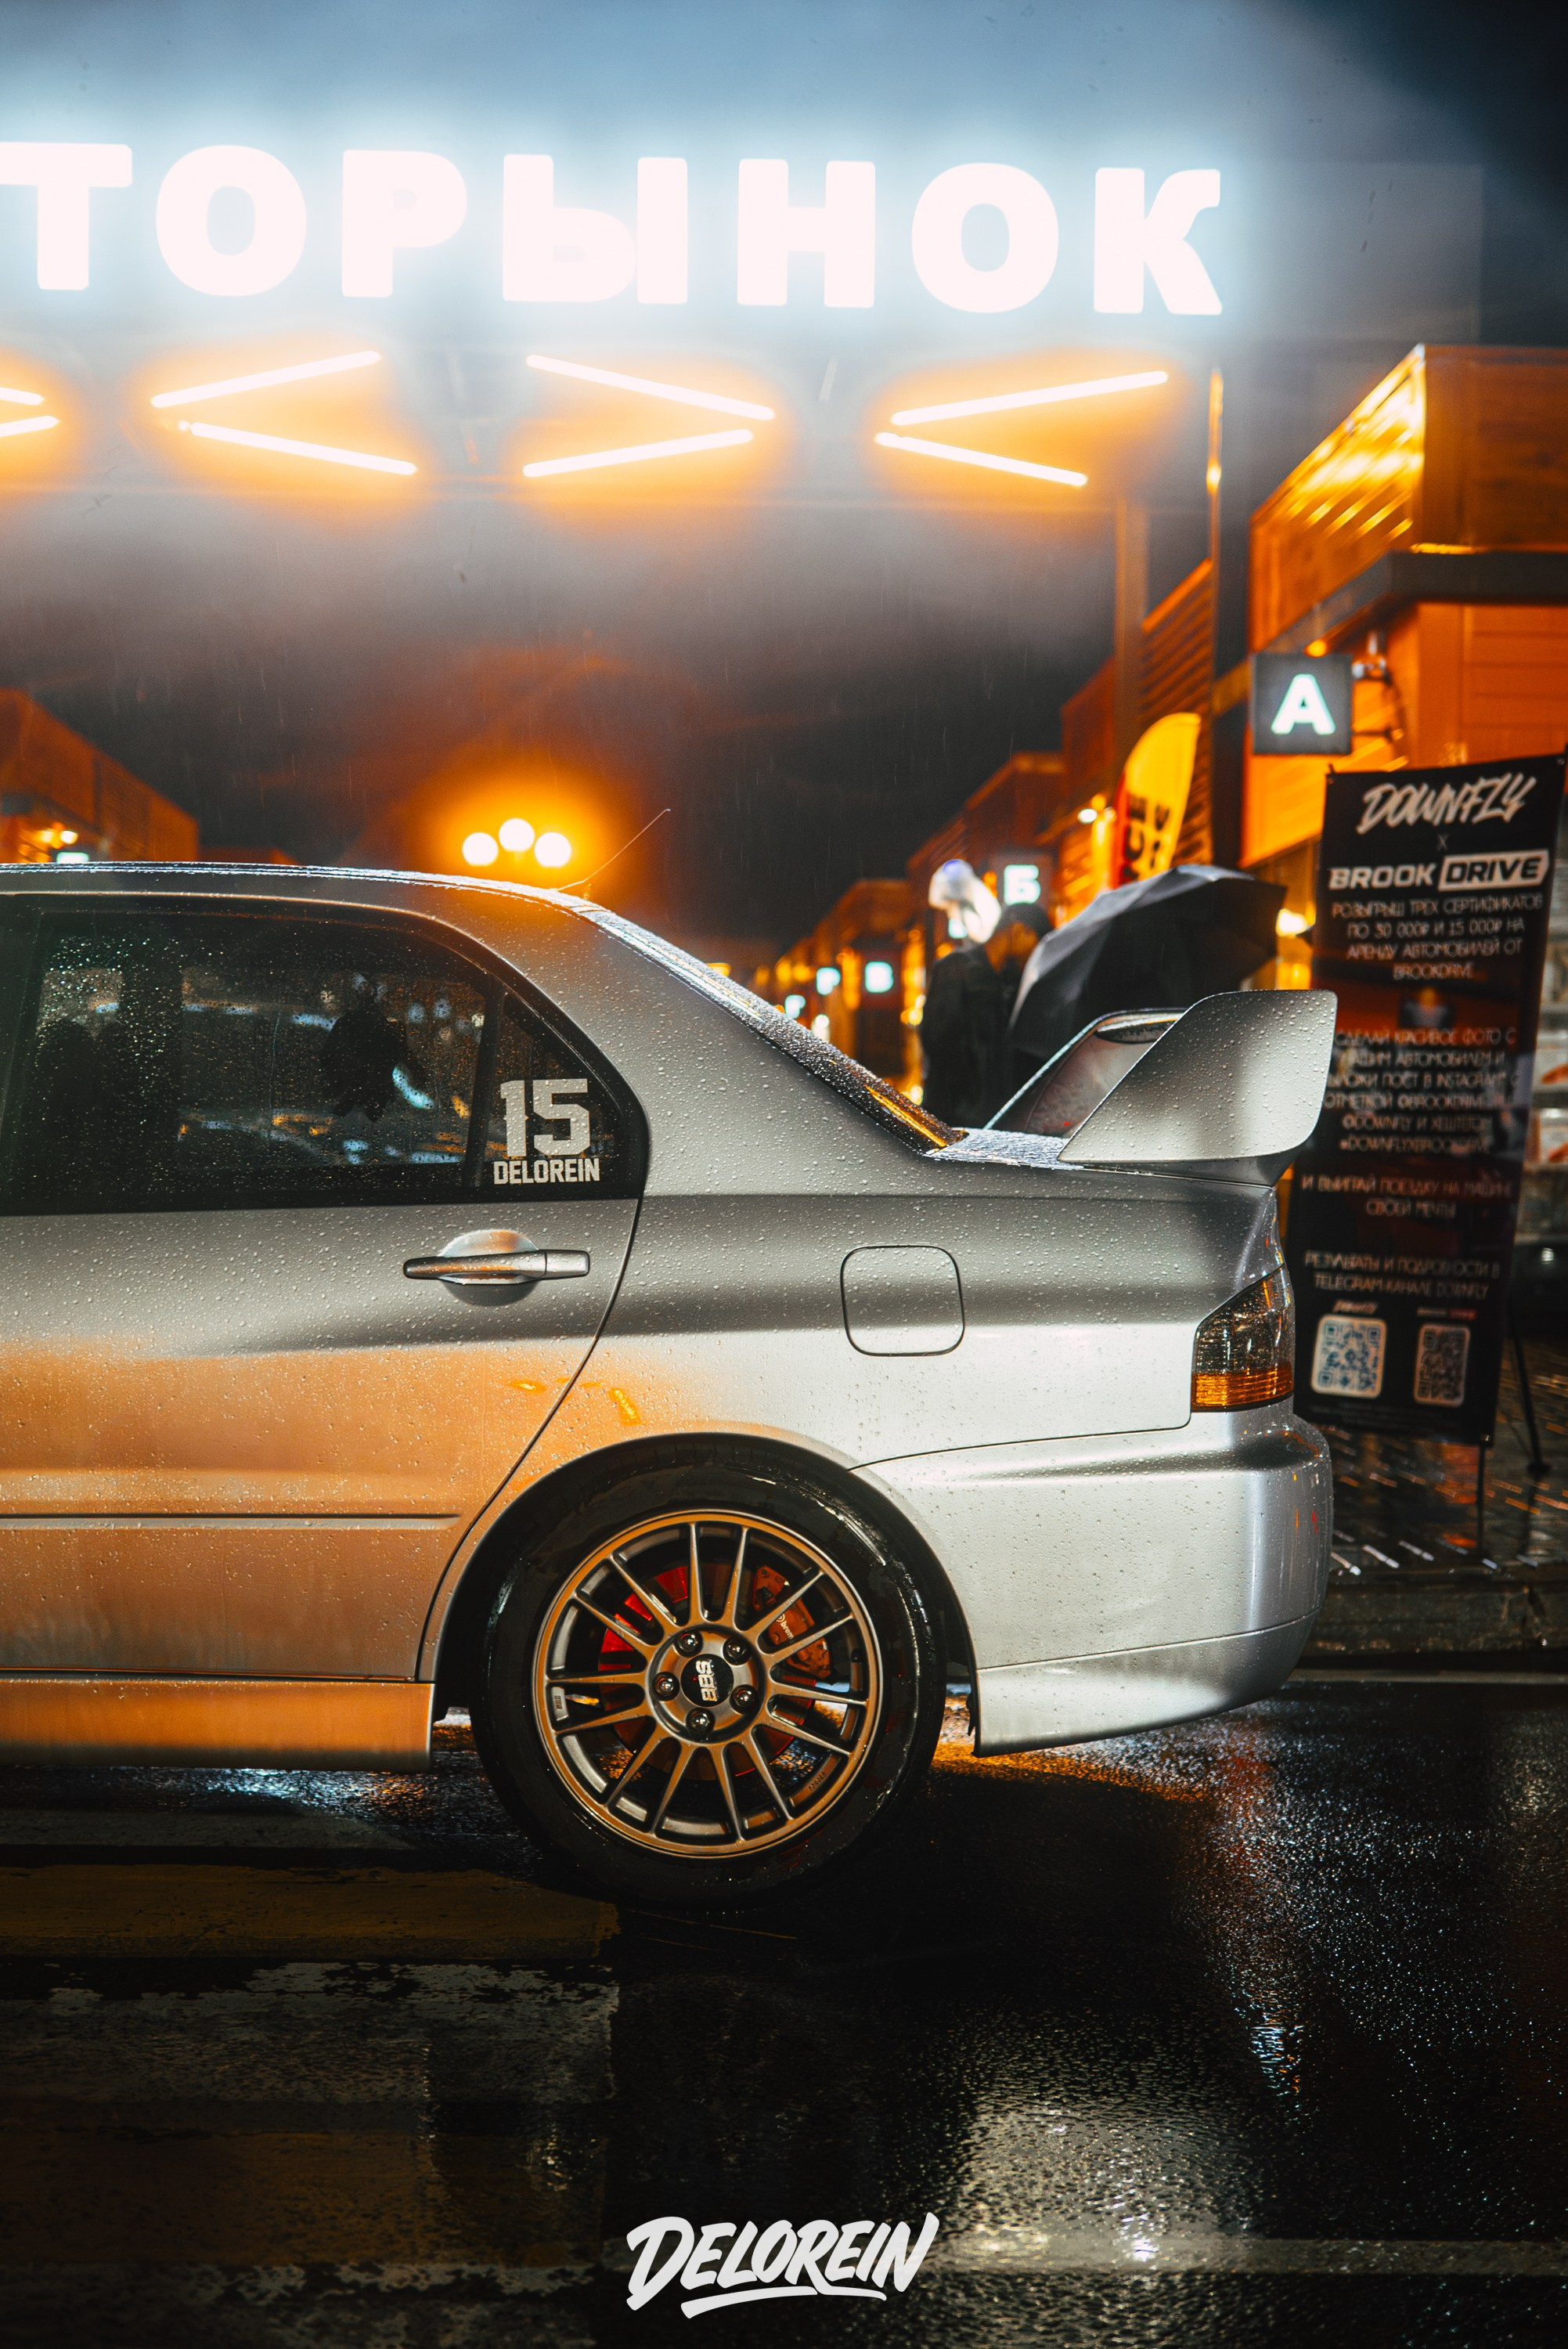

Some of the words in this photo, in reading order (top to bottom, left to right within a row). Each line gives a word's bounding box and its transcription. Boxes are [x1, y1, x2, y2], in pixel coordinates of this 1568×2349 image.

[0, 142, 1222, 316] ТОРЫНОК
[1271, 673, 1336, 735] А
[1004, 864, 1041, 905] Б
[1329, 863, 1437, 890] BROOK
[1447, 856, 1544, 886] DRIVE
[1347, 922, 1369, 939] ПО
[1434, 919, 1444, 936] И
[1449, 918, 1464, 936] 15
[1506, 918, 1524, 932] НА
[1504, 938, 1523, 954] ОТ
[1462, 1029, 1501, 1046] ФОТО
[1505, 1027, 1516, 1045] С
[500, 1078, 590, 1156] 15
[494, 1158, 600, 1185] DELOREIN
[696, 1660, 718, 1701] BBS
